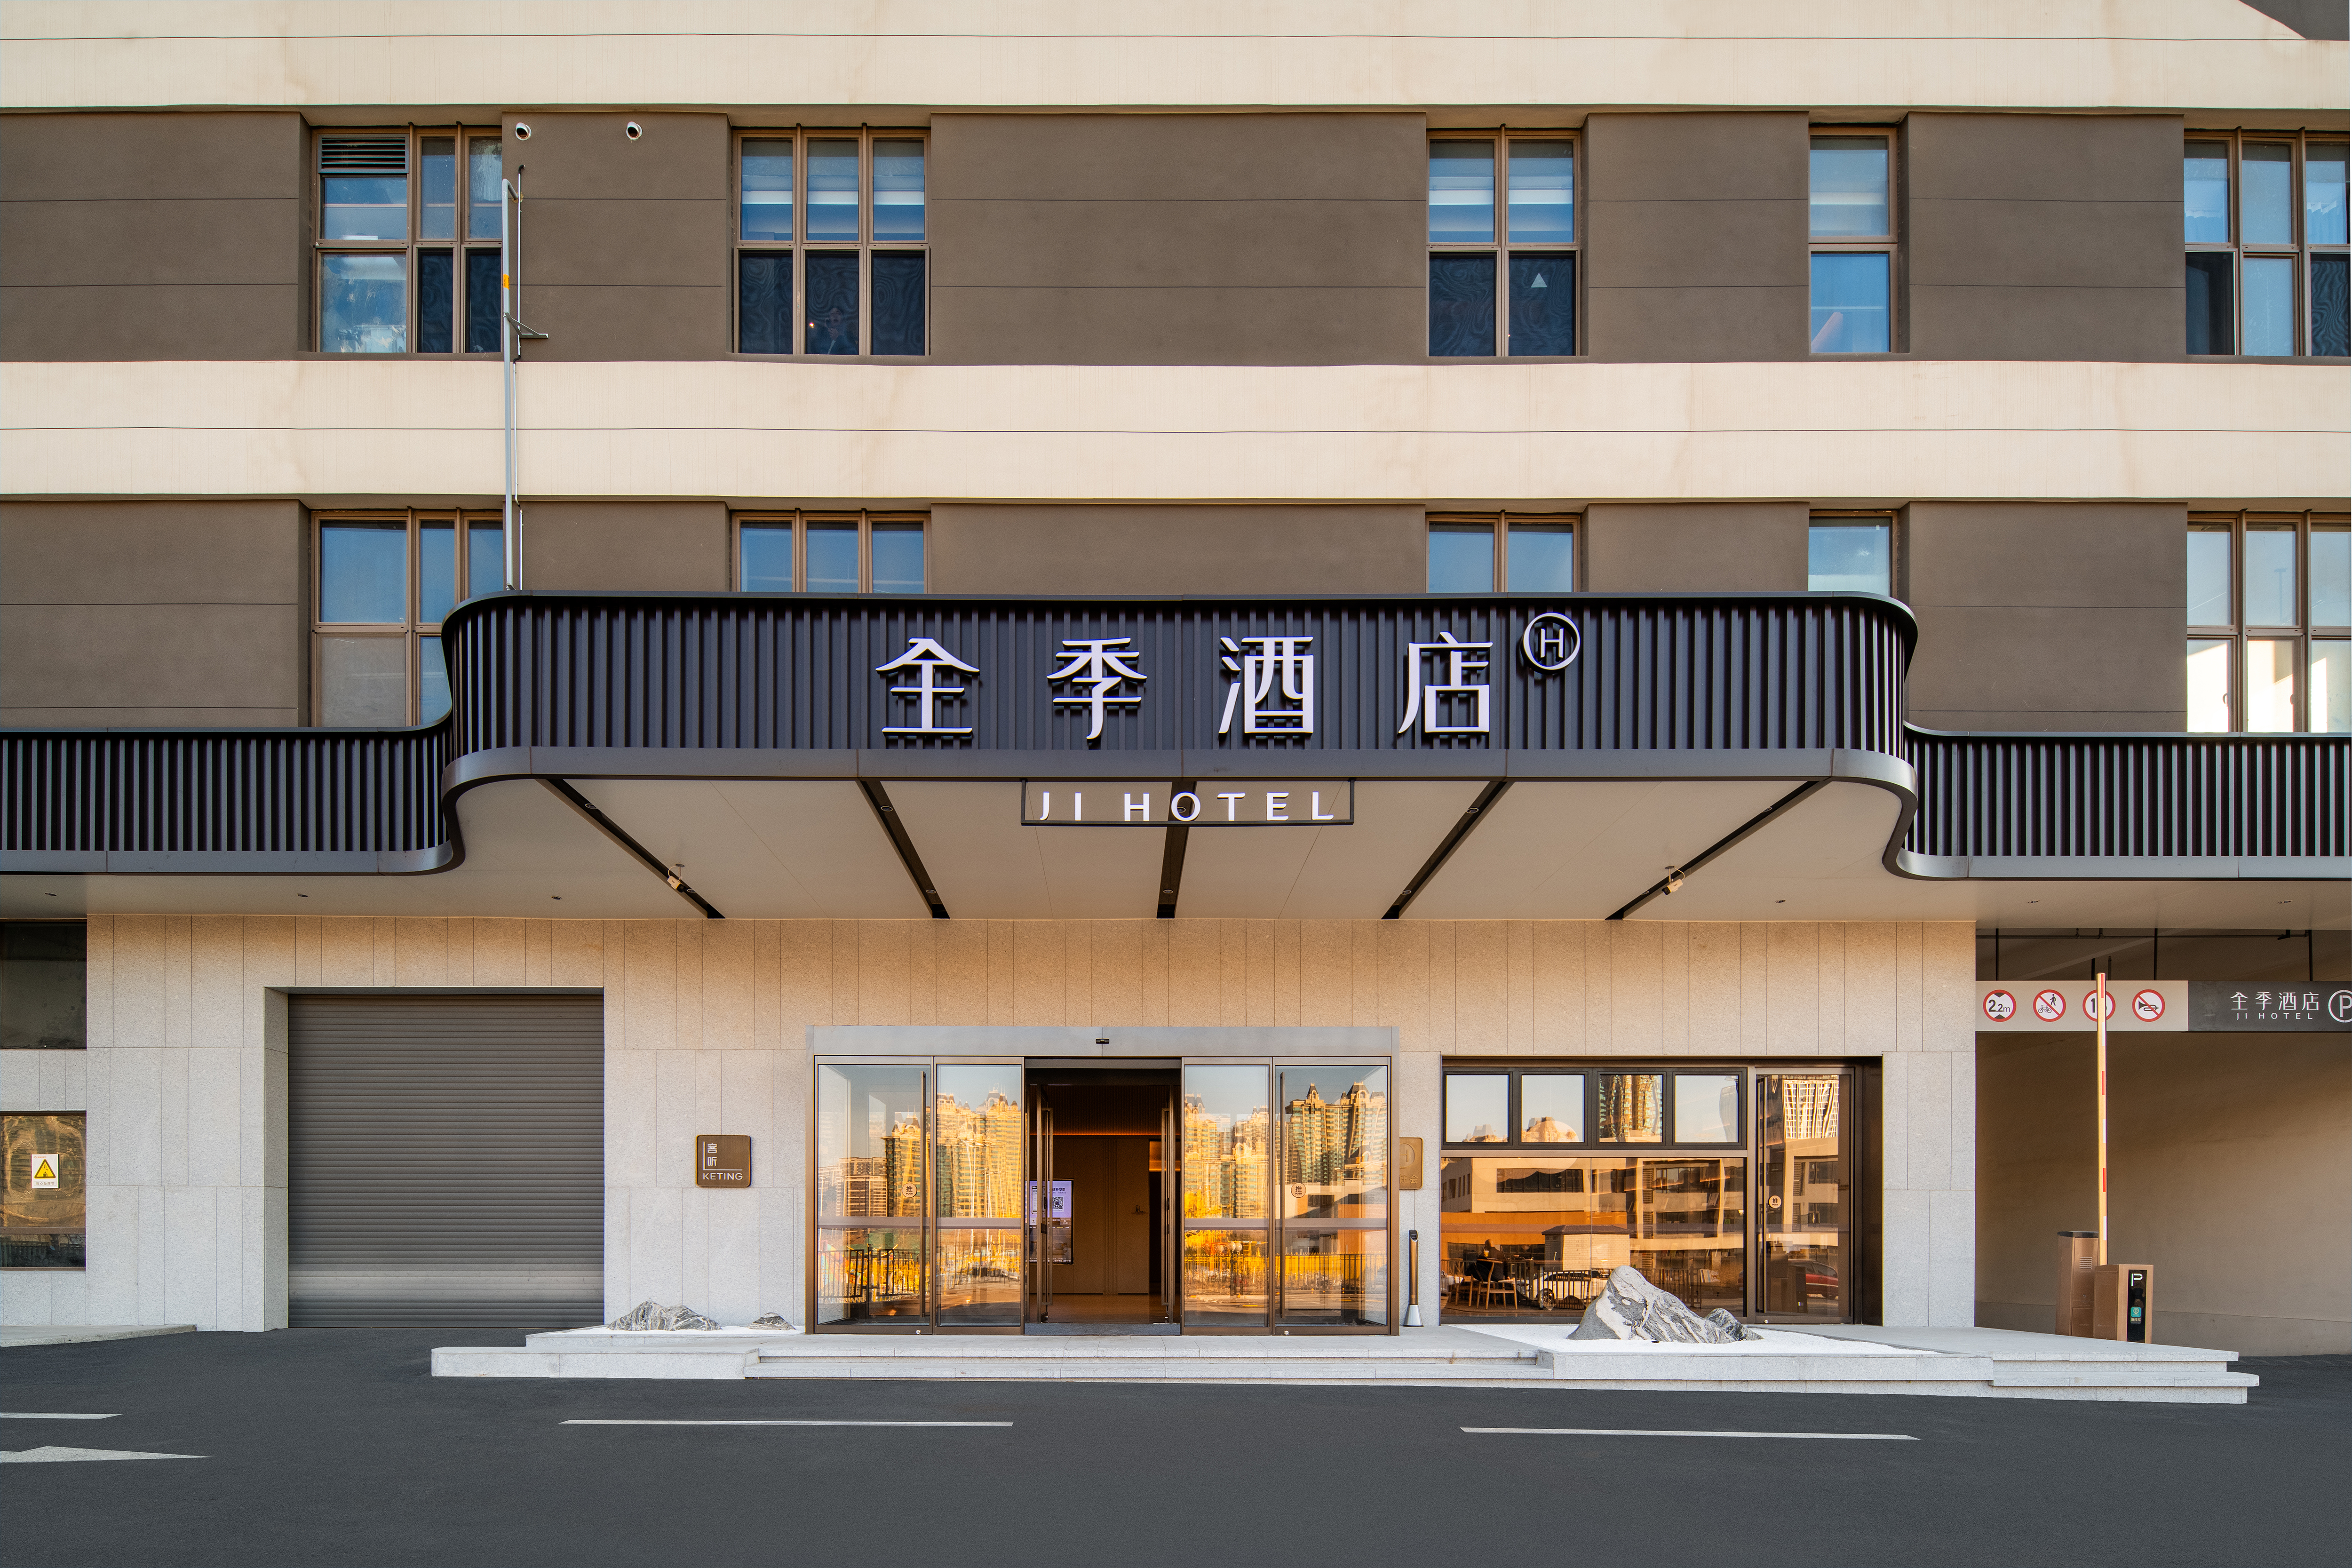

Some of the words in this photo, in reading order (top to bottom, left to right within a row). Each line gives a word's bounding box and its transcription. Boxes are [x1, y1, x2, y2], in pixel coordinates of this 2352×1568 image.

[876, 631, 1493, 740] 全季酒店
[1040, 792, 1081, 821] JI
[1124, 792, 1334, 821] HOTEL
[1988, 999, 2010, 1012] 2.2m
[2230, 991, 2319, 1011] 全季酒店
[2339, 995, 2352, 1017] P
[1399, 1174, 1419, 1184] 住会
[2131, 1273, 2143, 1286] P
